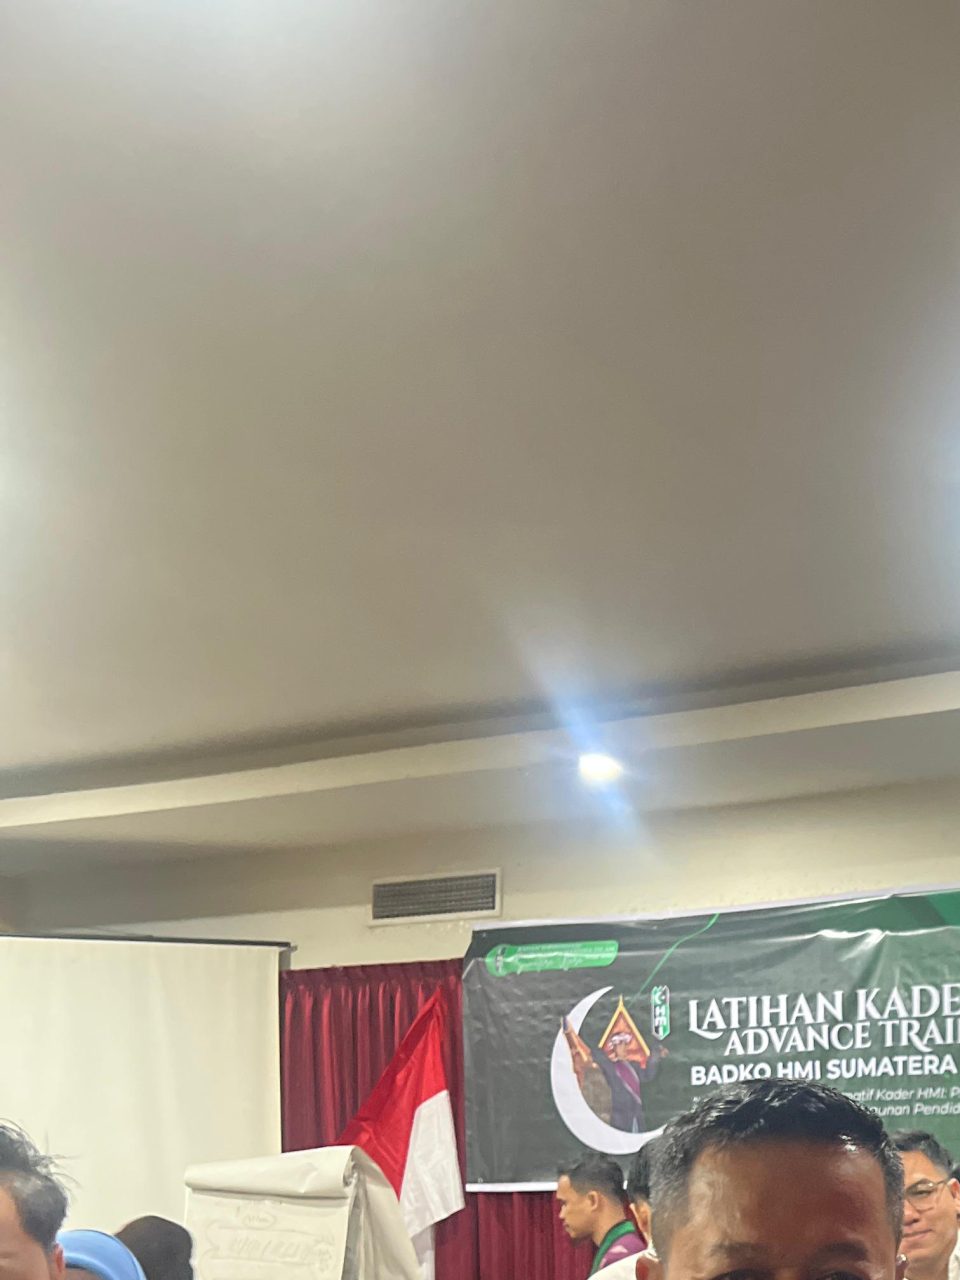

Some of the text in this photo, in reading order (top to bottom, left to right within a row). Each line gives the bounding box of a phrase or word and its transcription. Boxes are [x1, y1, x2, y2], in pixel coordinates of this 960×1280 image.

[688, 990, 844, 1040] LATIHAN
[724, 1021, 872, 1056] ADVANCE
[691, 1062, 772, 1086] BADKO
[777, 1060, 821, 1081] HMI
[826, 1054, 958, 1080] SUMATERA
[876, 1088, 915, 1101] Kader
